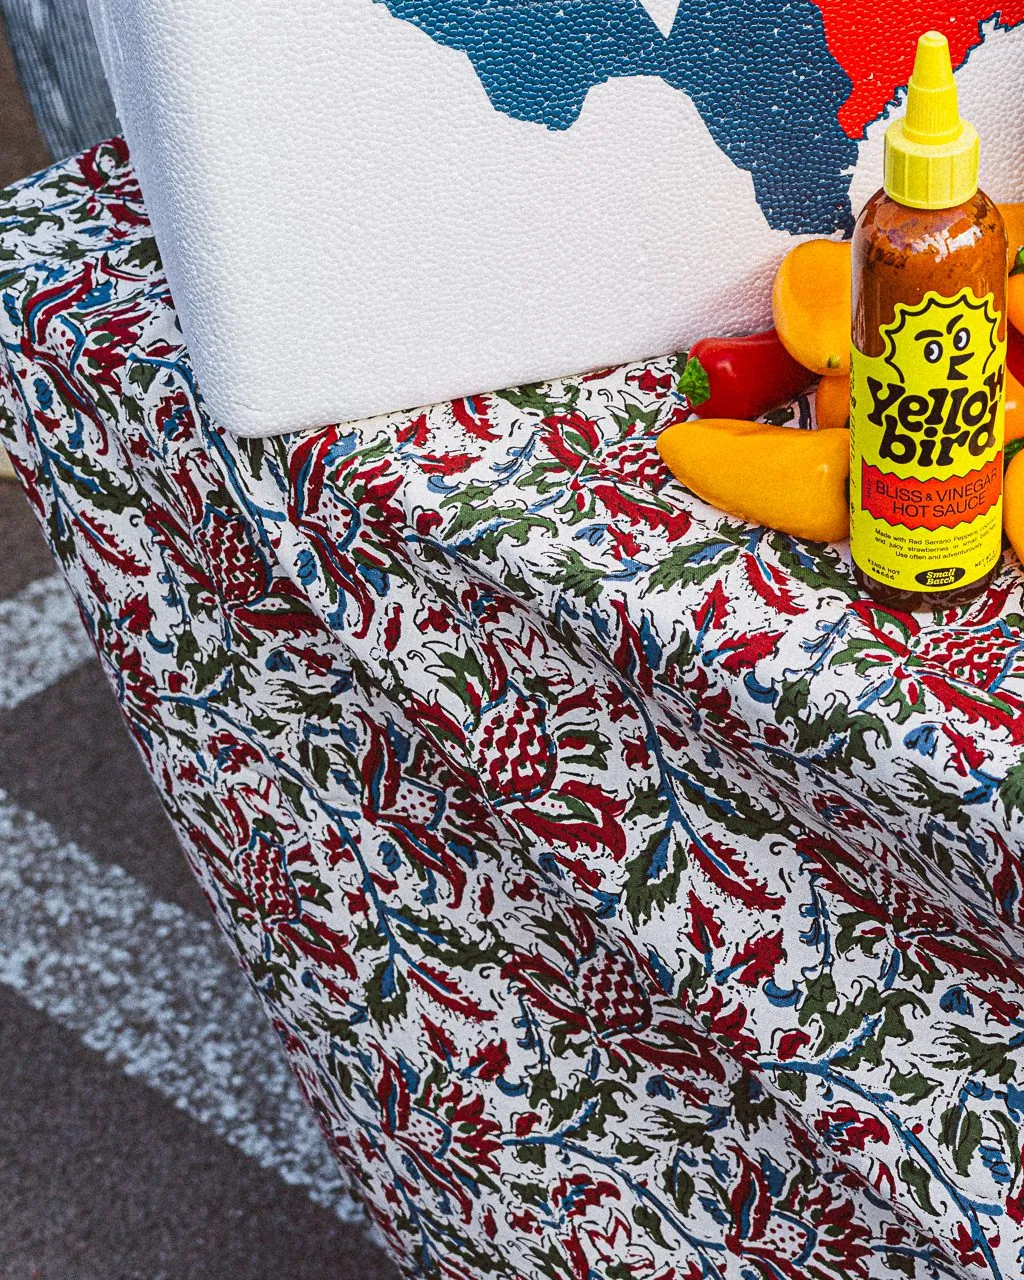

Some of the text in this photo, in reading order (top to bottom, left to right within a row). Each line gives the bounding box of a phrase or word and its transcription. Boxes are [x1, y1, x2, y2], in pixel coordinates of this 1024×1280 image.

[878, 400, 996, 468] bird
[875, 480, 923, 503] BLISS
[925, 493, 933, 502] &
[935, 468, 997, 503] VINEGAR
[893, 490, 986, 518] HOT SAUCE
[874, 536, 886, 545] and
[888, 542, 904, 552] juicy
[907, 546, 949, 554] strawberries
[875, 527, 892, 540] Made
[892, 534, 907, 543] with
[908, 536, 923, 545] Red
[924, 537, 952, 545] Serrano
[895, 551, 909, 559] Use
[927, 553, 941, 561] and
[867, 557, 901, 576] KINDA HOT
[925, 568, 957, 579] Small
[925, 574, 956, 586] Batch
